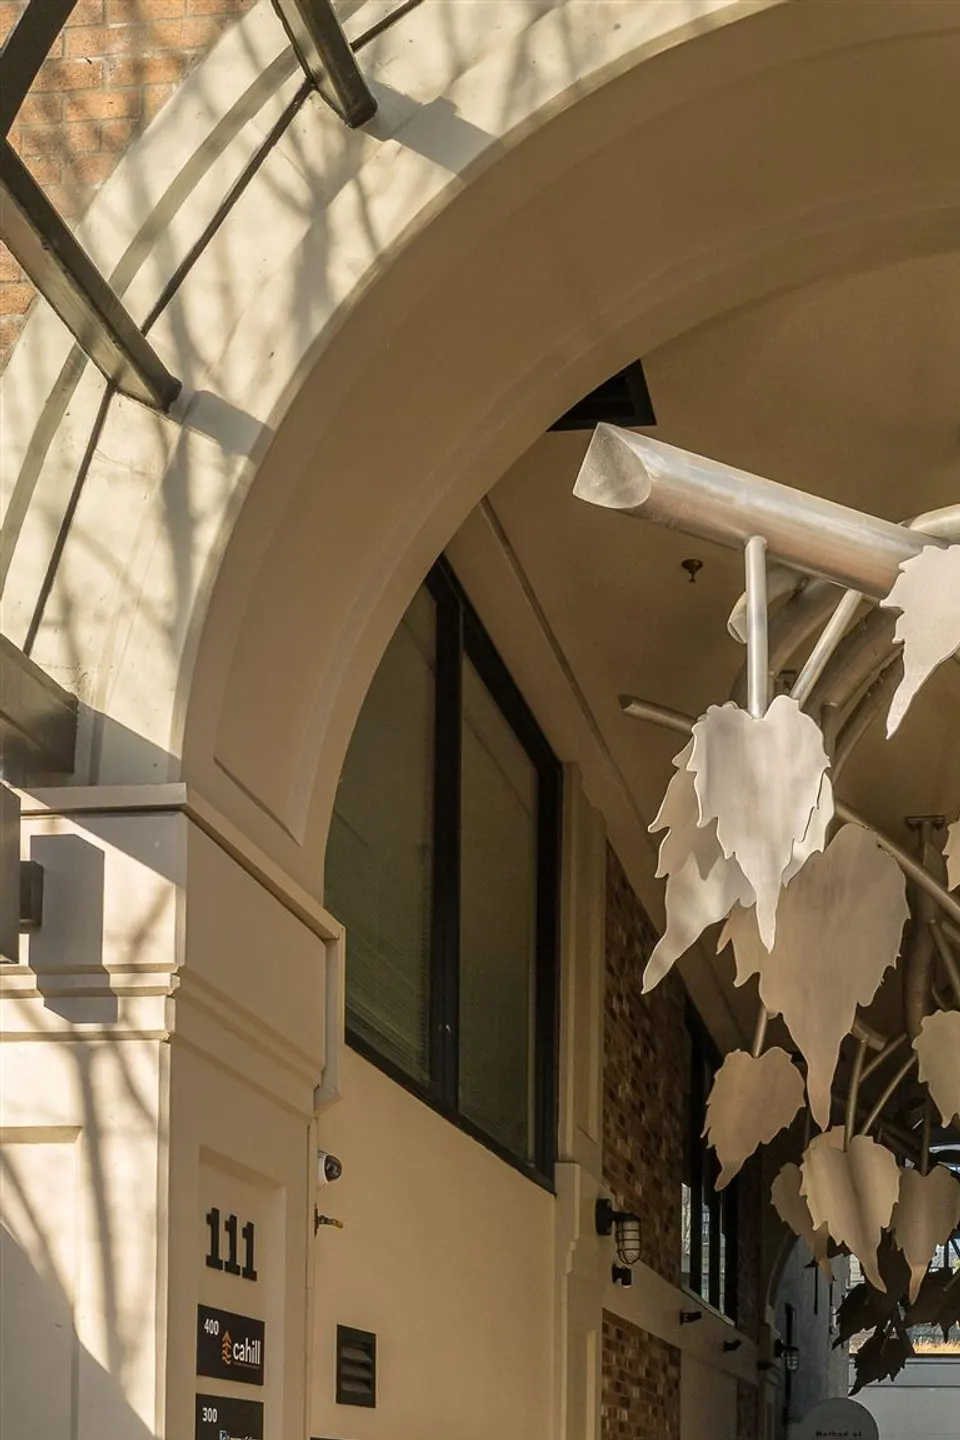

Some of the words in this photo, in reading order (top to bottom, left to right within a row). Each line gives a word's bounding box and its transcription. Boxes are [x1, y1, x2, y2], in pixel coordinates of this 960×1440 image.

[206, 1208, 257, 1281] 111
[203, 1319, 220, 1336] 400
[232, 1338, 261, 1364] cahill
[202, 1407, 218, 1423] 300
